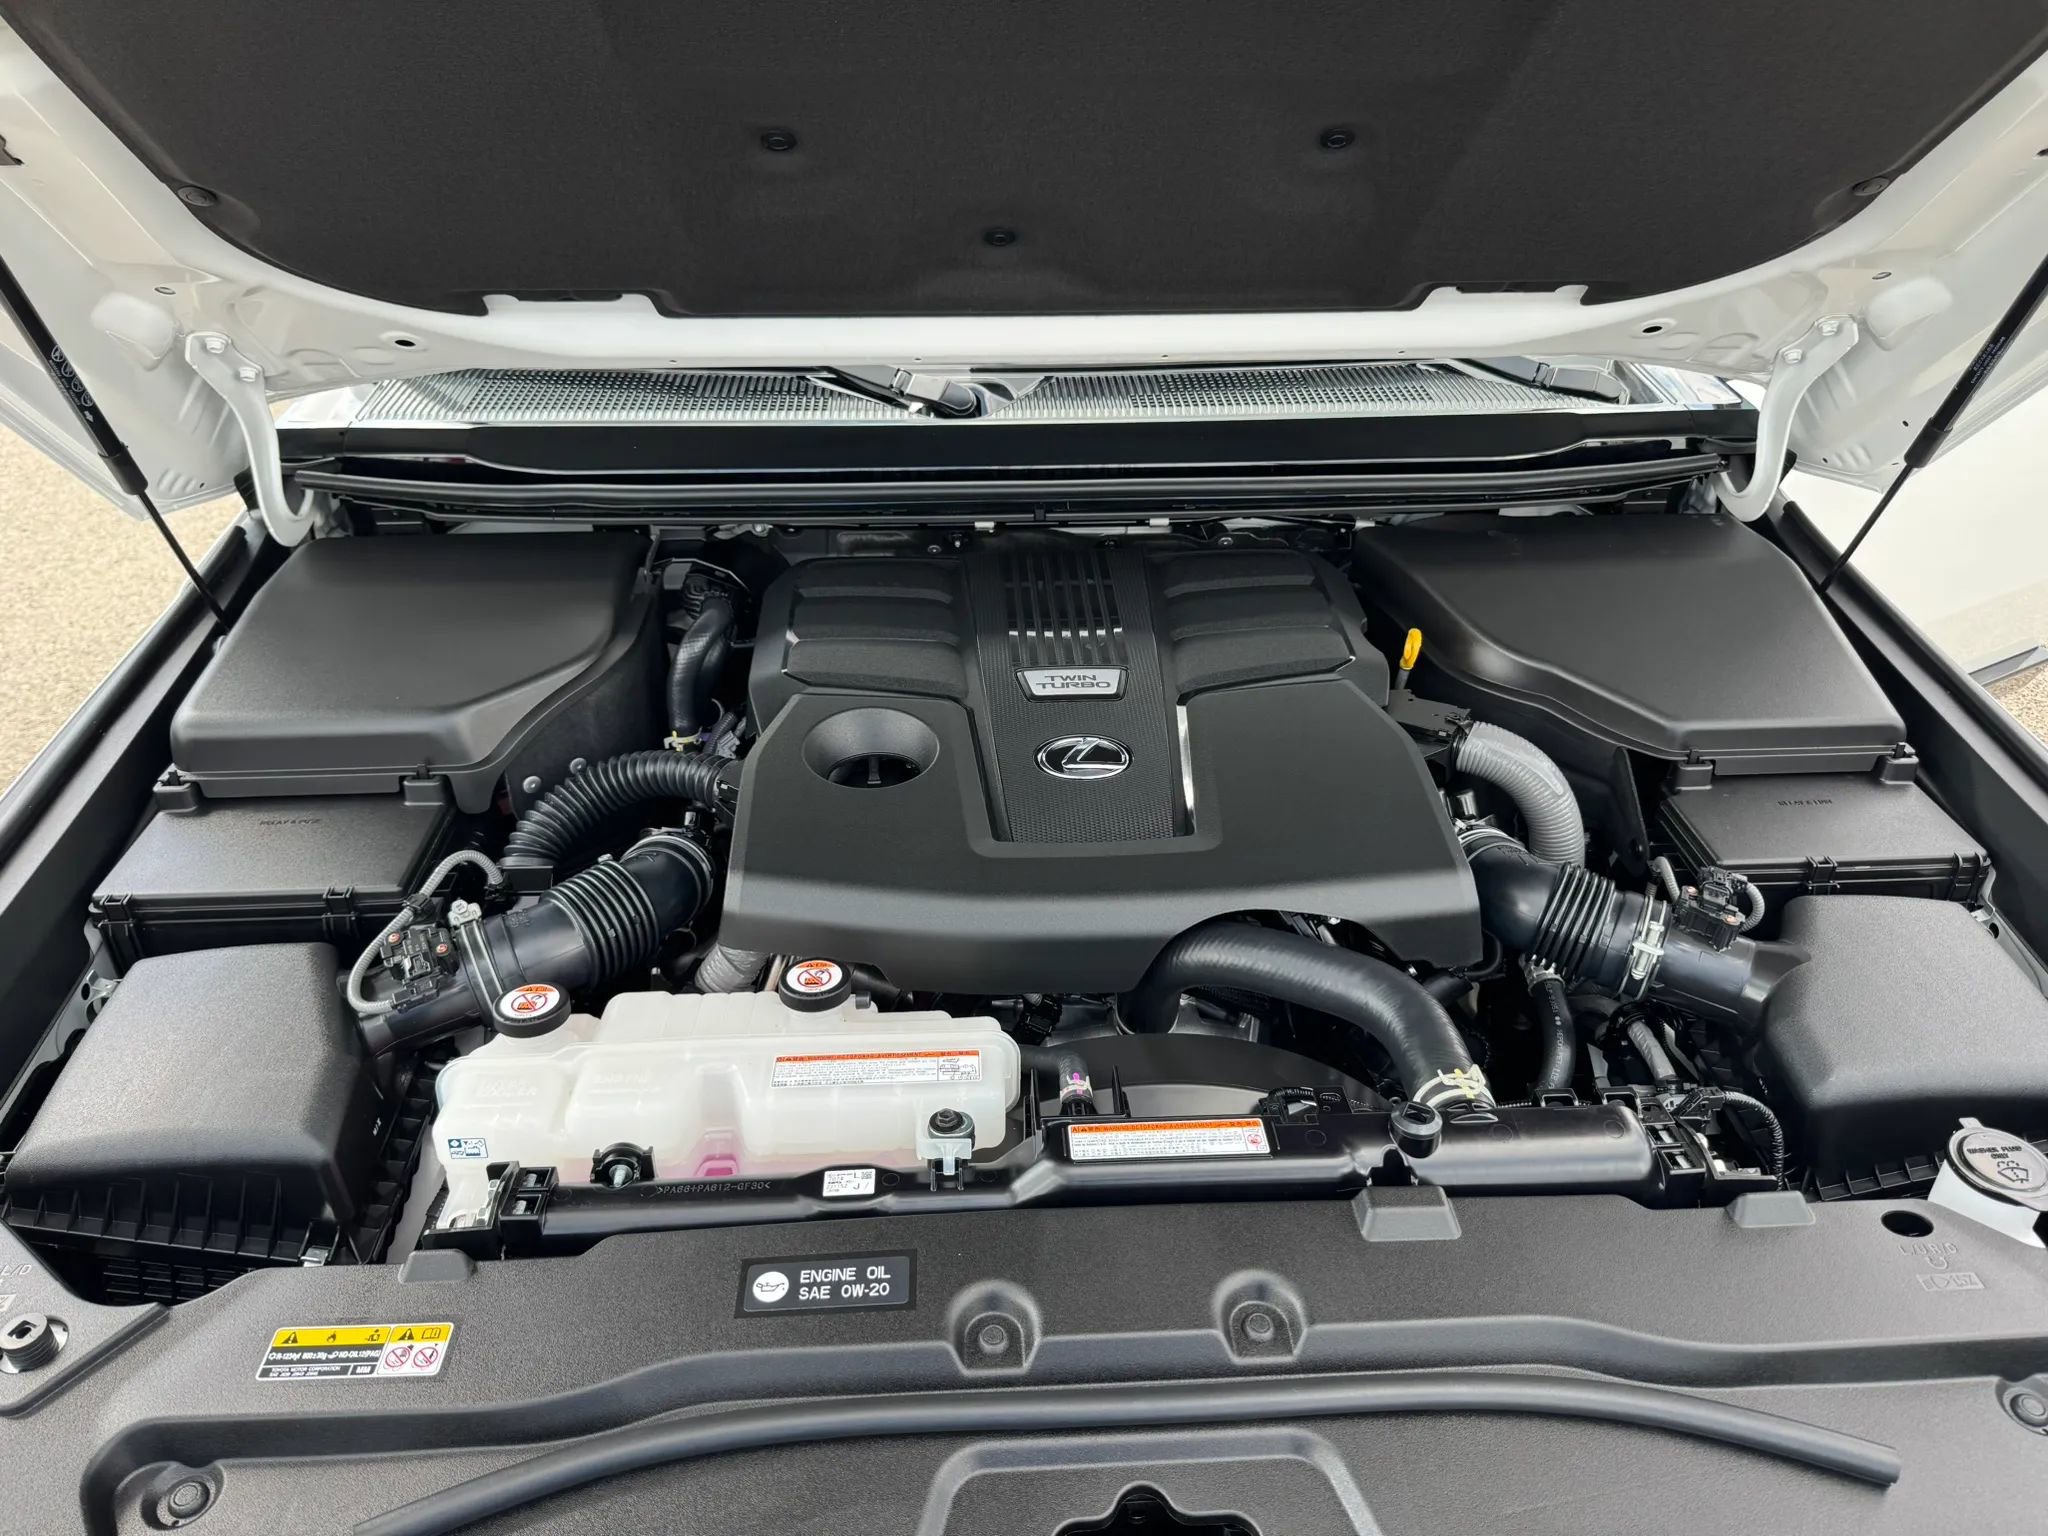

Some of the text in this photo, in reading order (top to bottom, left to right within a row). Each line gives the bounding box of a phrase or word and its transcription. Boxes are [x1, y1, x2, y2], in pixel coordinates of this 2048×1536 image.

[1036, 681, 1111, 689] TURBO
[800, 1265, 891, 1284] ENGINE OIL
[798, 1282, 891, 1301] SAE 0W-20
